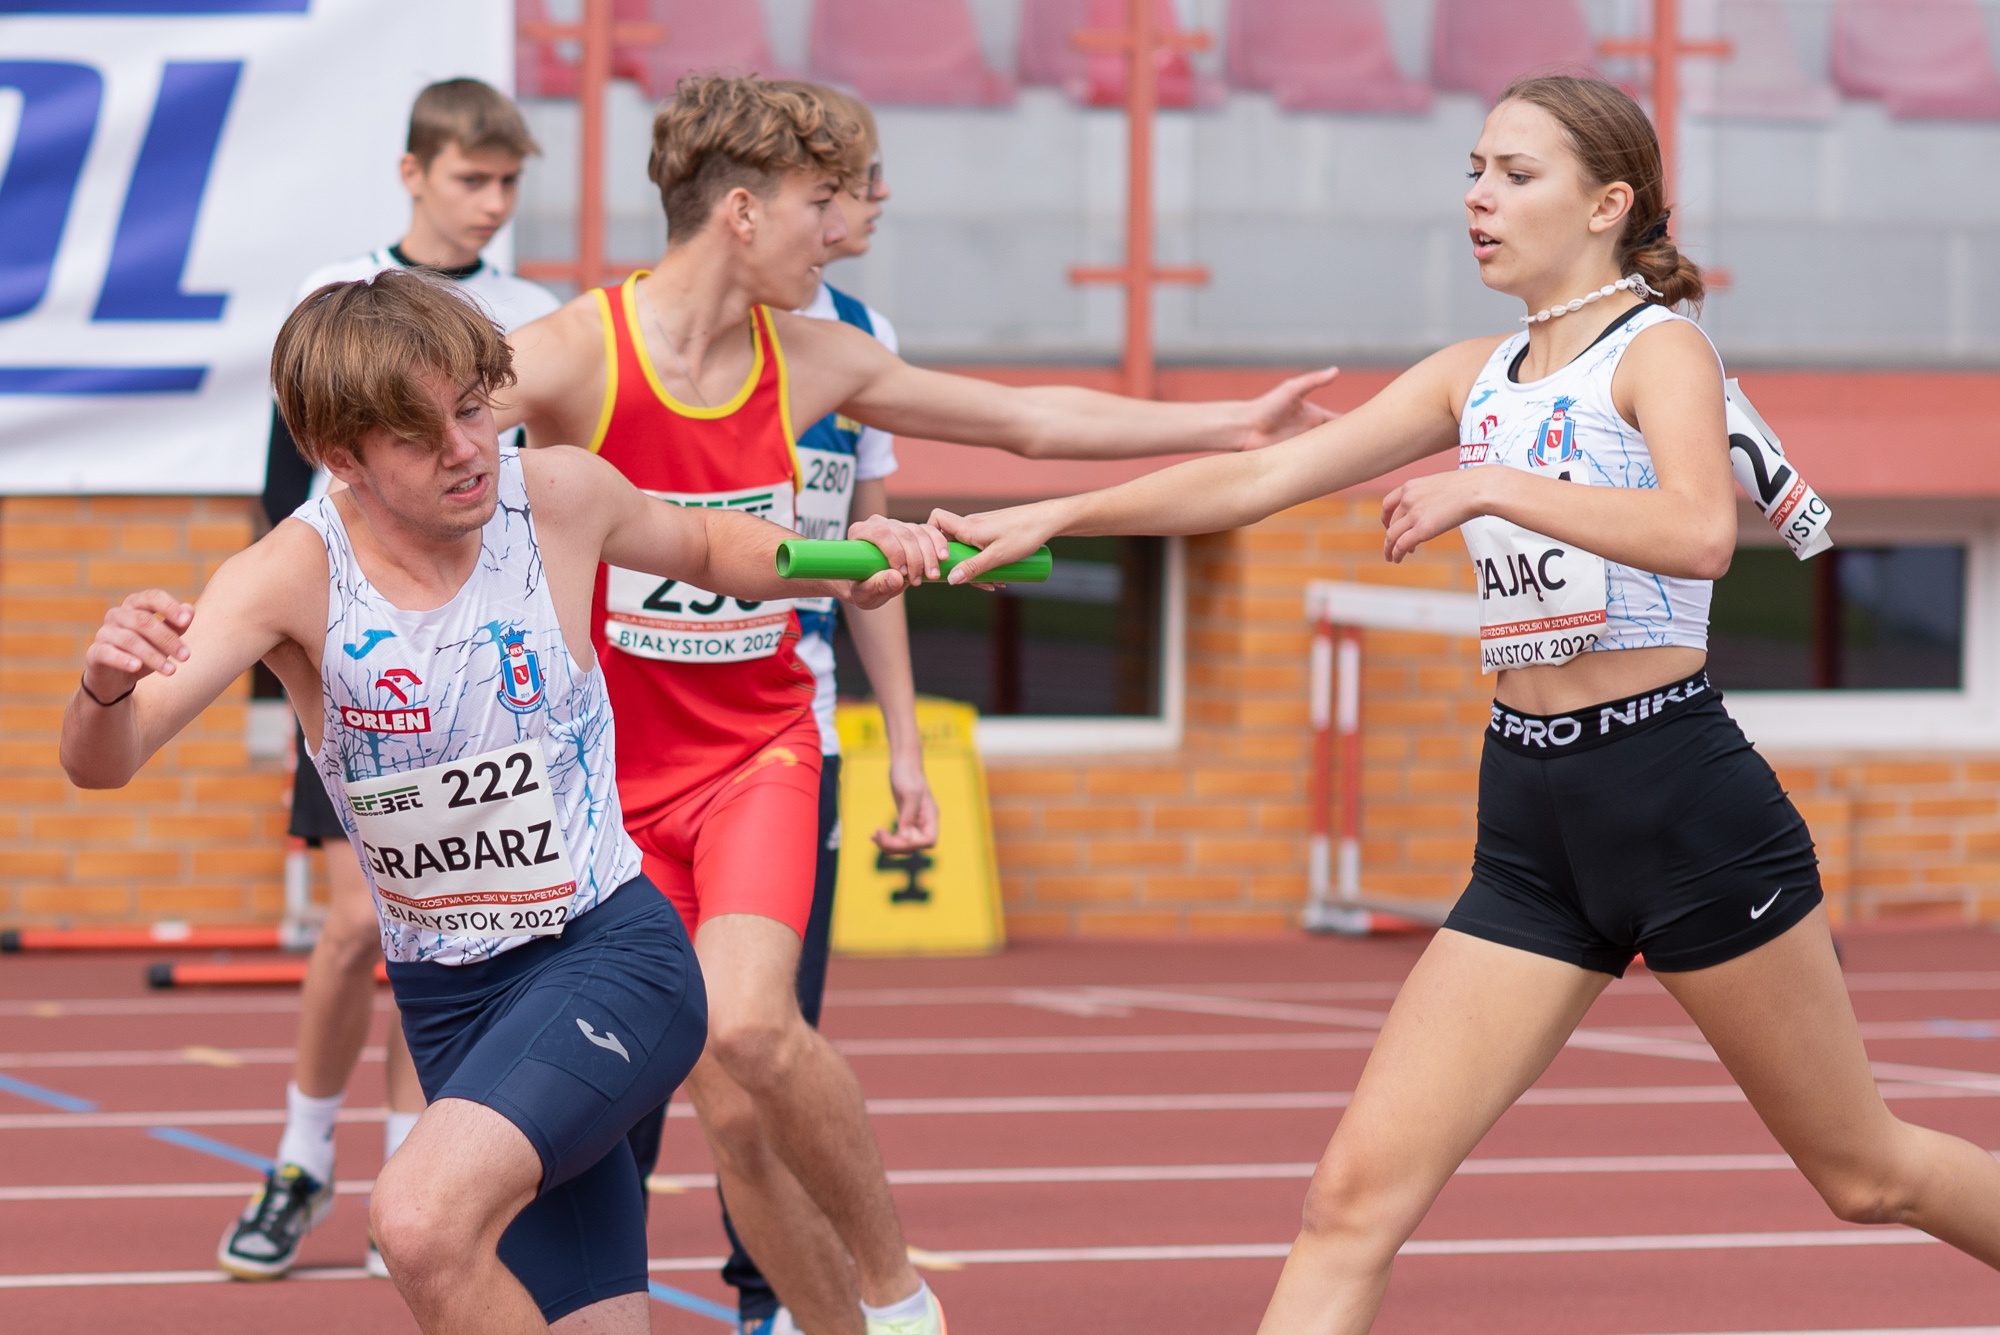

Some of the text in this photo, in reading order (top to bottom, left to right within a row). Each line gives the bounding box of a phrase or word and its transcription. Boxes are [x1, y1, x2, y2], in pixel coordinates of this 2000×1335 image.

[805, 457, 850, 494] 280
[1785, 497, 1826, 552] YSTO
[1519, 621, 1543, 633] POLSKI
[1543, 620, 1551, 629] W
[1551, 613, 1602, 629] SZTAFETACH
[619, 630, 783, 656] BIAŁYSTOK 2022
[345, 709, 427, 731] ORLEN
[1503, 713, 1582, 748] PRO
[347, 752, 540, 815] EFBET 222
[362, 820, 560, 880] GRABARZ
[464, 894, 499, 904] POLSKI
[499, 894, 509, 903] W
[510, 884, 573, 903] SZTAFETACH
[387, 903, 569, 931] BIAŁYSTOK 2022
